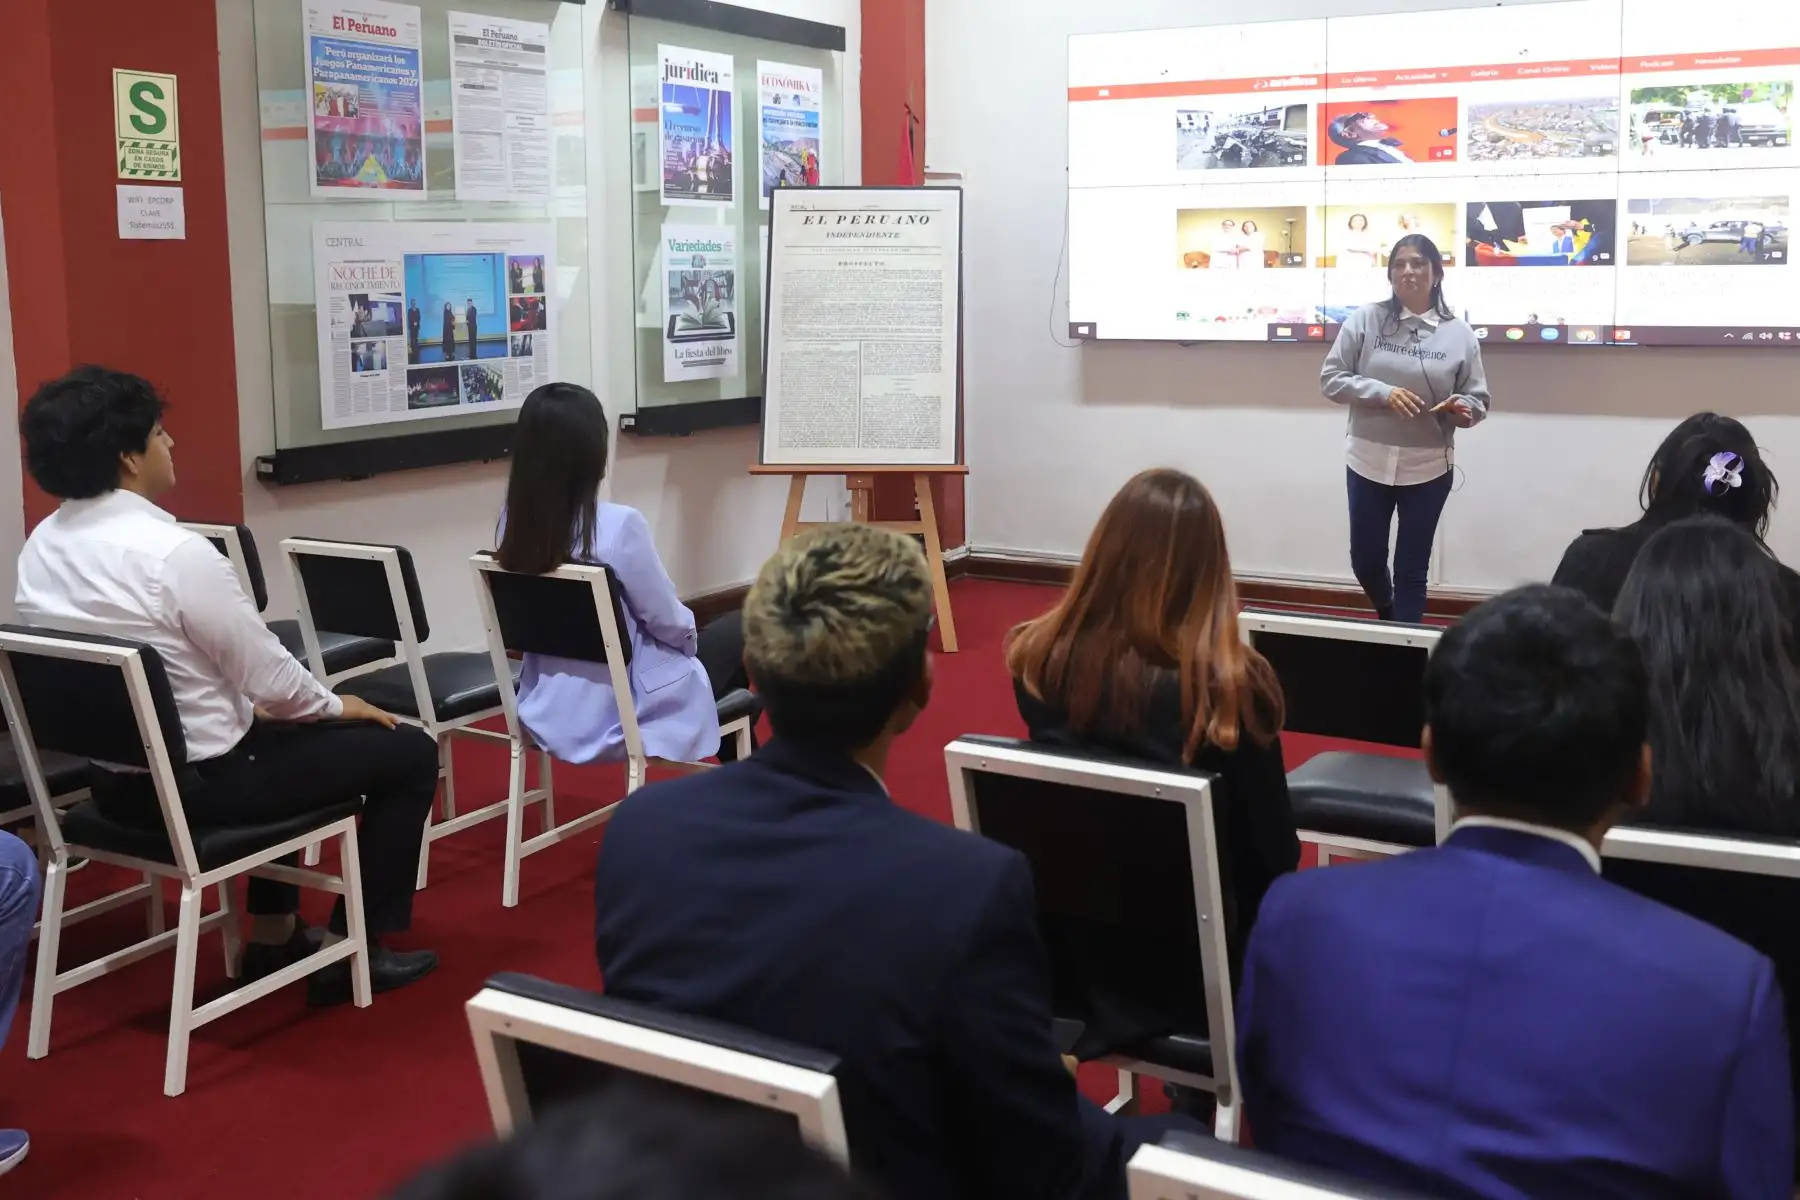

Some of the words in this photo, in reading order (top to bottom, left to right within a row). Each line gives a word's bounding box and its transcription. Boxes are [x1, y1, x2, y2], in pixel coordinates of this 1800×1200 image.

[332, 15, 344, 31] El
[348, 17, 397, 37] Peruano
[482, 28, 490, 37] El
[491, 30, 518, 41] Peruano
[324, 46, 347, 58] Perú
[347, 51, 393, 63] organizará
[395, 55, 406, 65] los
[315, 56, 345, 69] Juegos
[129, 80, 167, 135] S
[140, 209, 160, 217] CLAVE
[802, 215, 828, 225] EL
[836, 214, 931, 226] PERUANO
[826, 231, 901, 239] INDEPENDIENTE
[326, 237, 364, 247] CENTRAL
[668, 238, 722, 252] Variedades
[333, 265, 377, 280] NOCHE
[380, 265, 397, 279] DE
[330, 280, 400, 291] RECONOCIMIENTO
[674, 349, 684, 360] La
[685, 347, 704, 359] fiesta
[705, 346, 716, 357] del
[716, 345, 732, 356] libro
[1408, 346, 1447, 360] elegance
